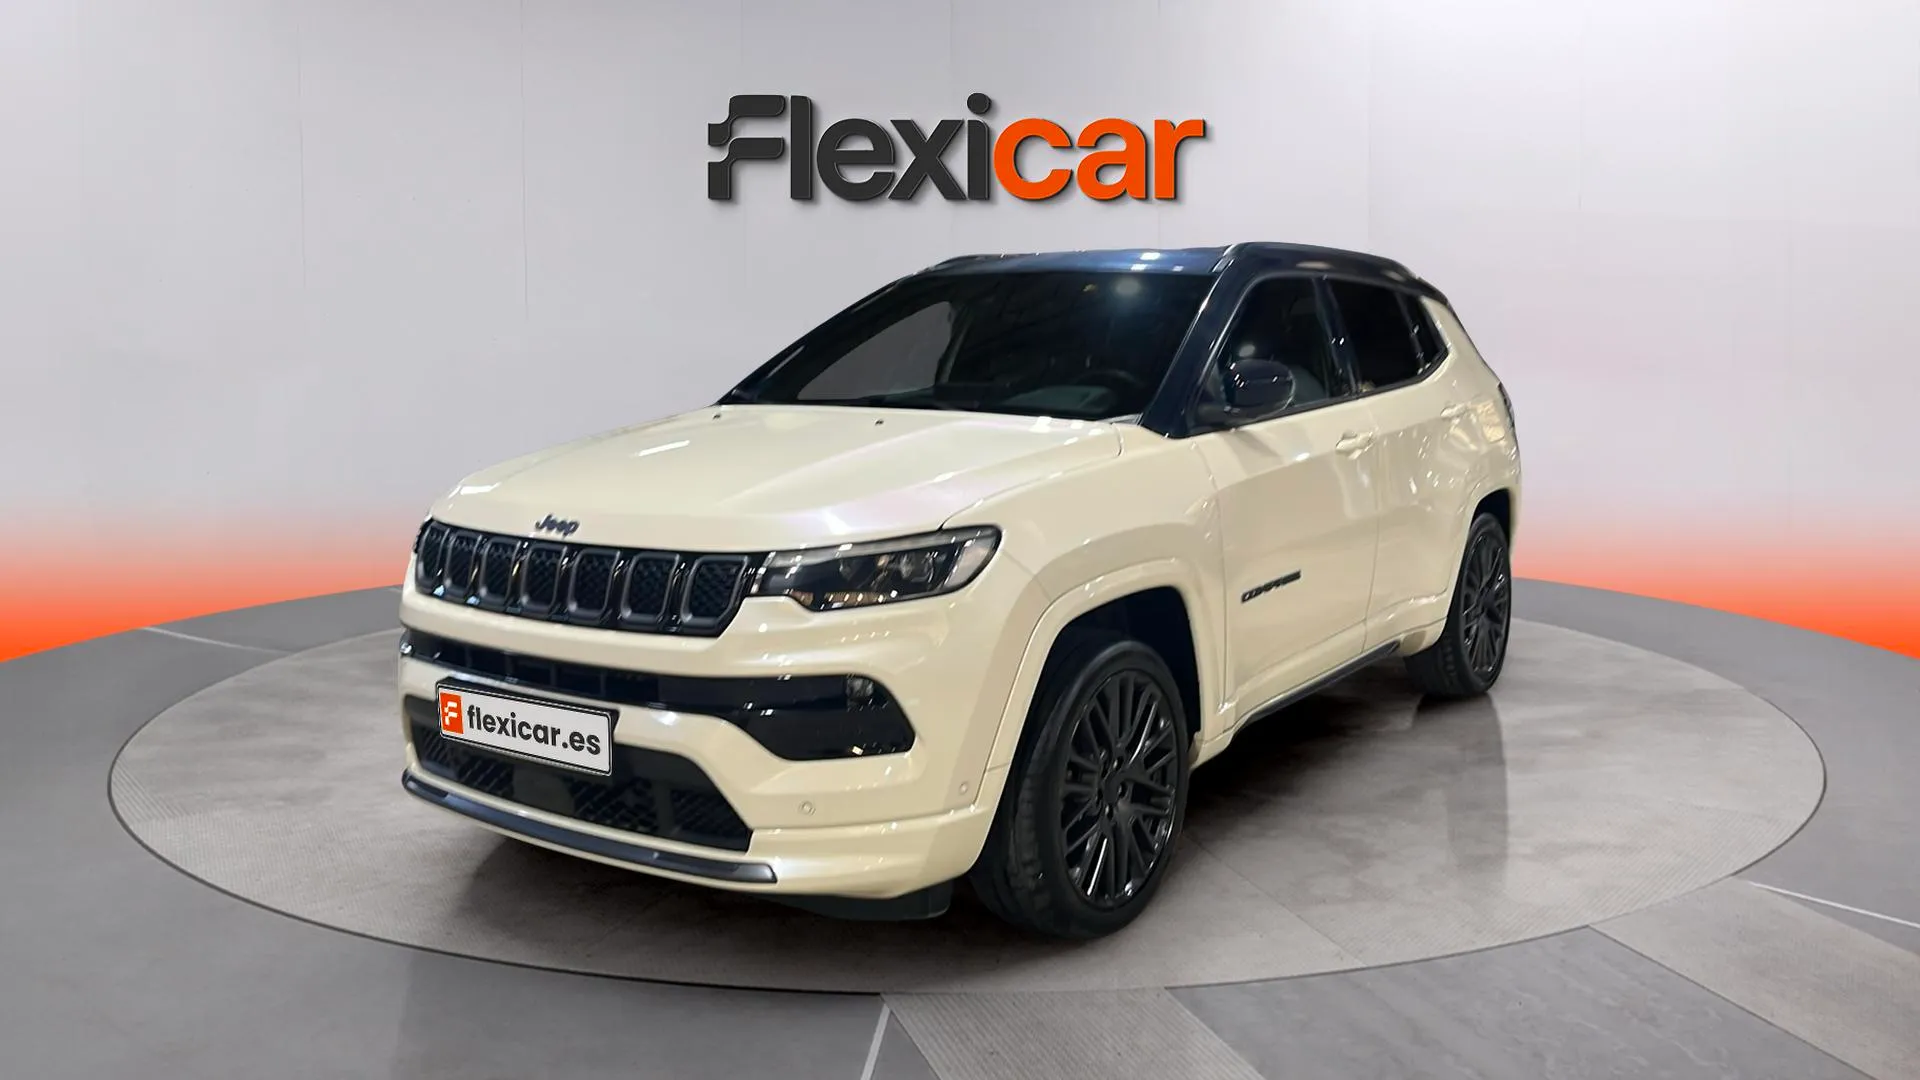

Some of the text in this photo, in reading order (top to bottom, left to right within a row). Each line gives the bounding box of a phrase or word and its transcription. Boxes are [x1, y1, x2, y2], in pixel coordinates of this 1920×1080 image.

[707, 92, 1206, 201] Flexicar
[534, 513, 580, 537] Jeep
[467, 704, 601, 756] flexicar.es
